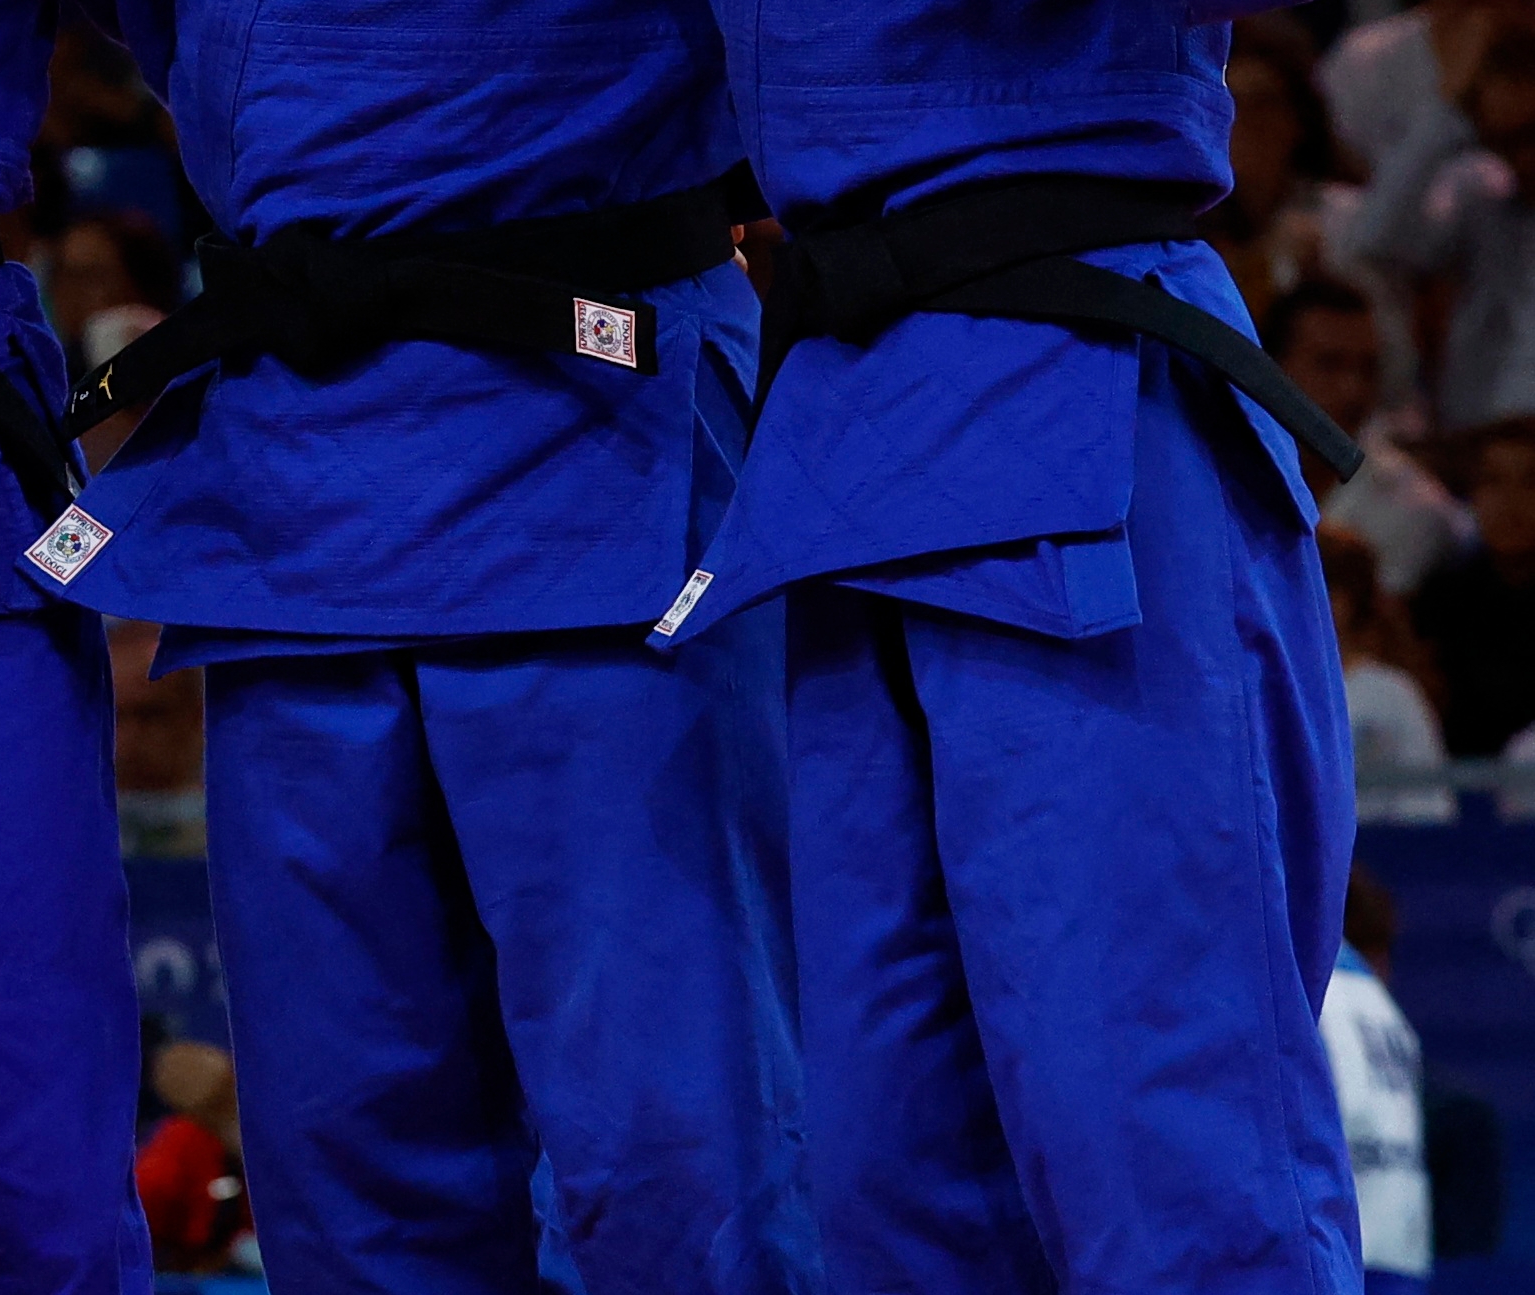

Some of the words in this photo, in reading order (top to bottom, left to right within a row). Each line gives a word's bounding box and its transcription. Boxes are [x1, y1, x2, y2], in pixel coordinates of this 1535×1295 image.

[579, 303, 587, 347] APPROVED
[622, 319, 631, 357] JUDOGI
[69, 512, 105, 540] APPROVED
[35, 550, 68, 576] JUDOGI
